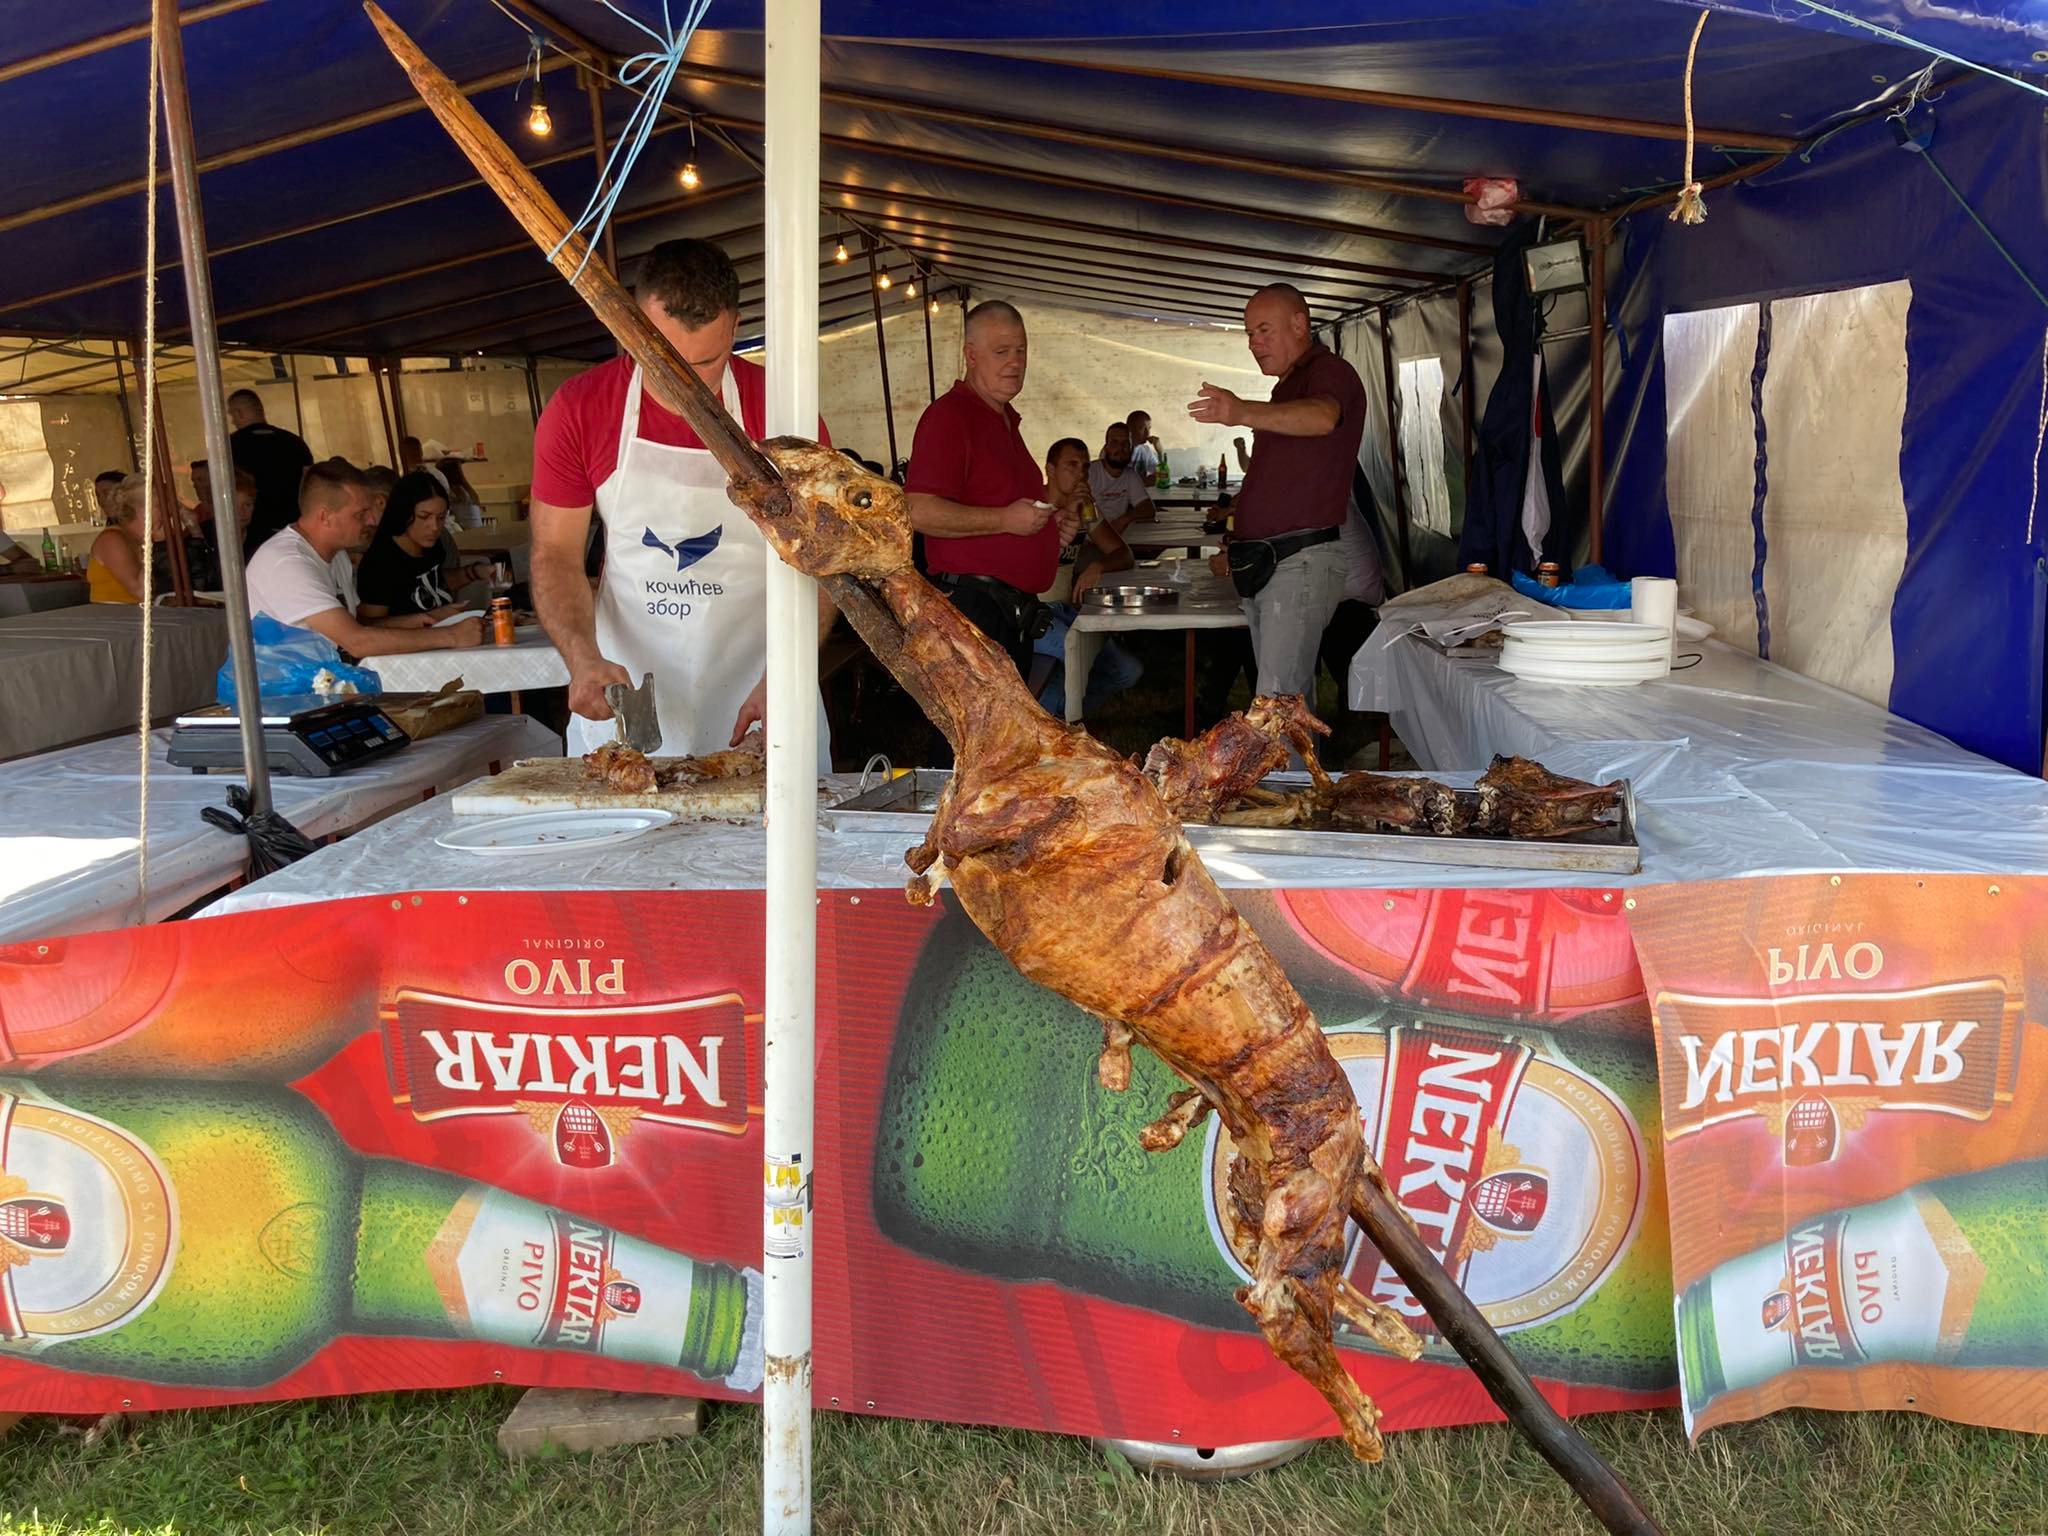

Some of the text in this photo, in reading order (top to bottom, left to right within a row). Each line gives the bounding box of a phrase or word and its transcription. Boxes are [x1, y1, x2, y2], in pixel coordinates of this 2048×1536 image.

[645, 579, 724, 595] кочићев
[646, 598, 692, 620] збор
[522, 938, 606, 950] ORIGINAL
[504, 958, 626, 995] PIVO
[420, 1029, 728, 1107] NEKTAR
[1554, 1077, 1627, 1174] PROIZVODIMO
[141, 1201, 156, 1223] SA
[1614, 1182, 1627, 1206] SA
[1565, 1213, 1622, 1292] PONOSOM
[517, 1240, 545, 1312] PIVO
[557, 1220, 604, 1346] NEKTAR
